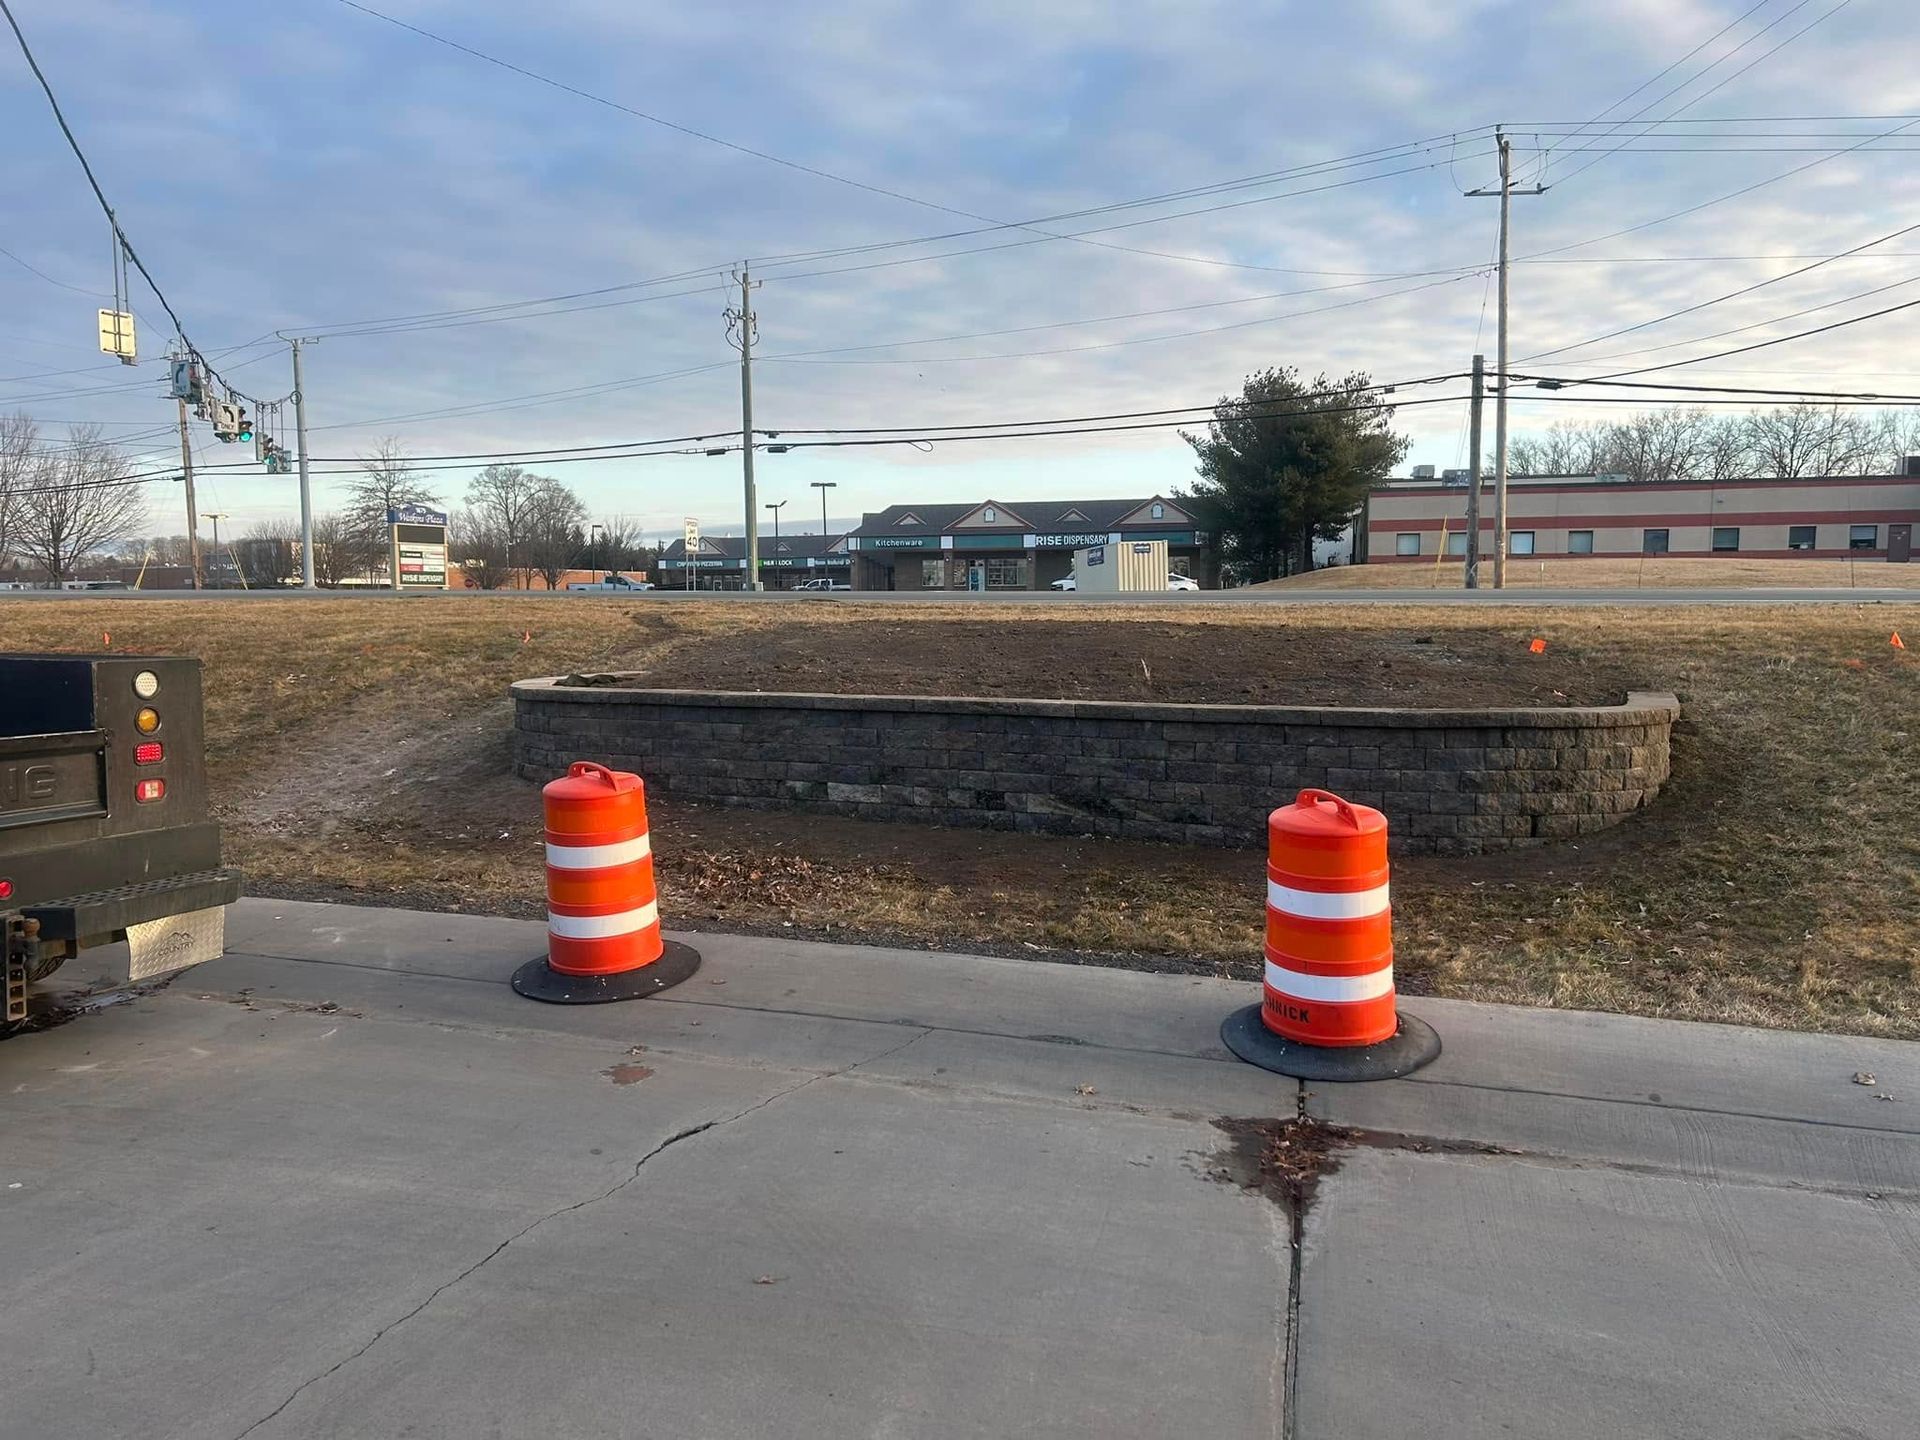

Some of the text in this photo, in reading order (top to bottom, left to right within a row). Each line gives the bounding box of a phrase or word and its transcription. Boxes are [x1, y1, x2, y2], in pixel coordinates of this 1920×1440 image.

[686, 536, 698, 548] 40
[875, 539, 923, 547] Kitchenware
[1036, 534, 1108, 546] RISE DISPENSARY
[158, 941, 194, 957] COUNTRY
